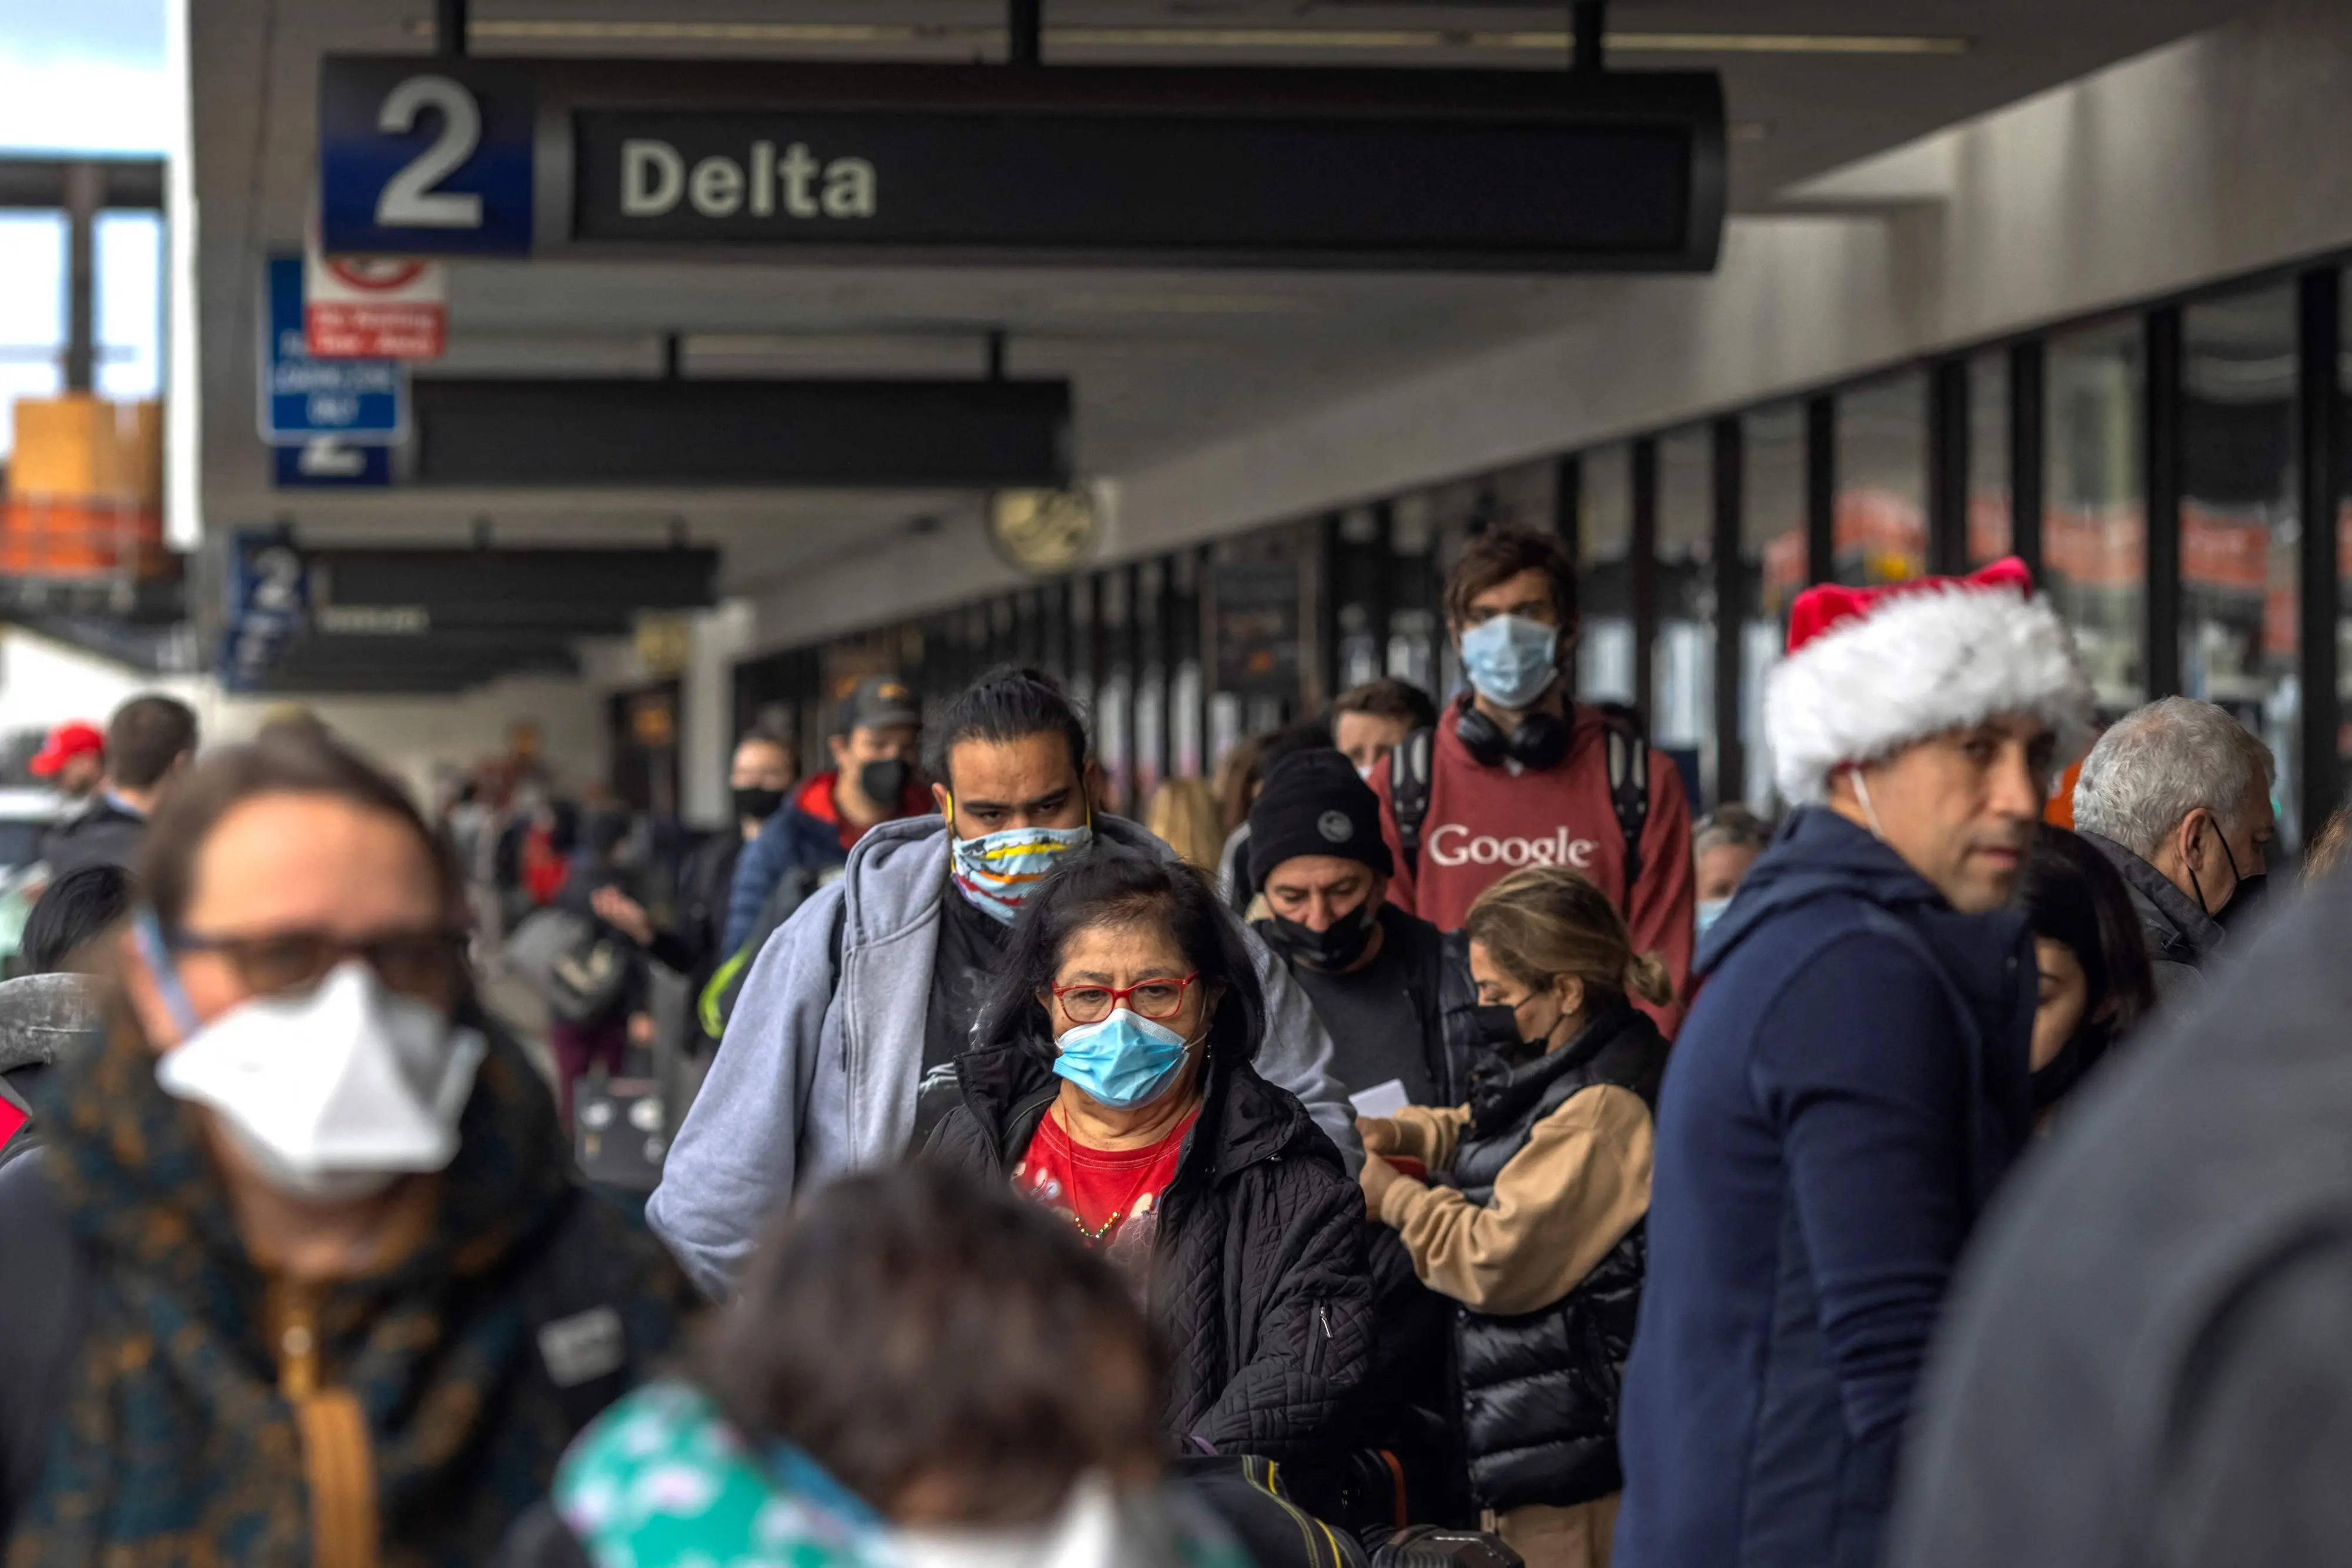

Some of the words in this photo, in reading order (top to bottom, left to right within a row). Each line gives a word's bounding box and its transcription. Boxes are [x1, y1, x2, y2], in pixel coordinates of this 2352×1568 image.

[374, 73, 483, 229] 2
[620, 139, 878, 218] Delta
[1428, 823, 1593, 867] Google
